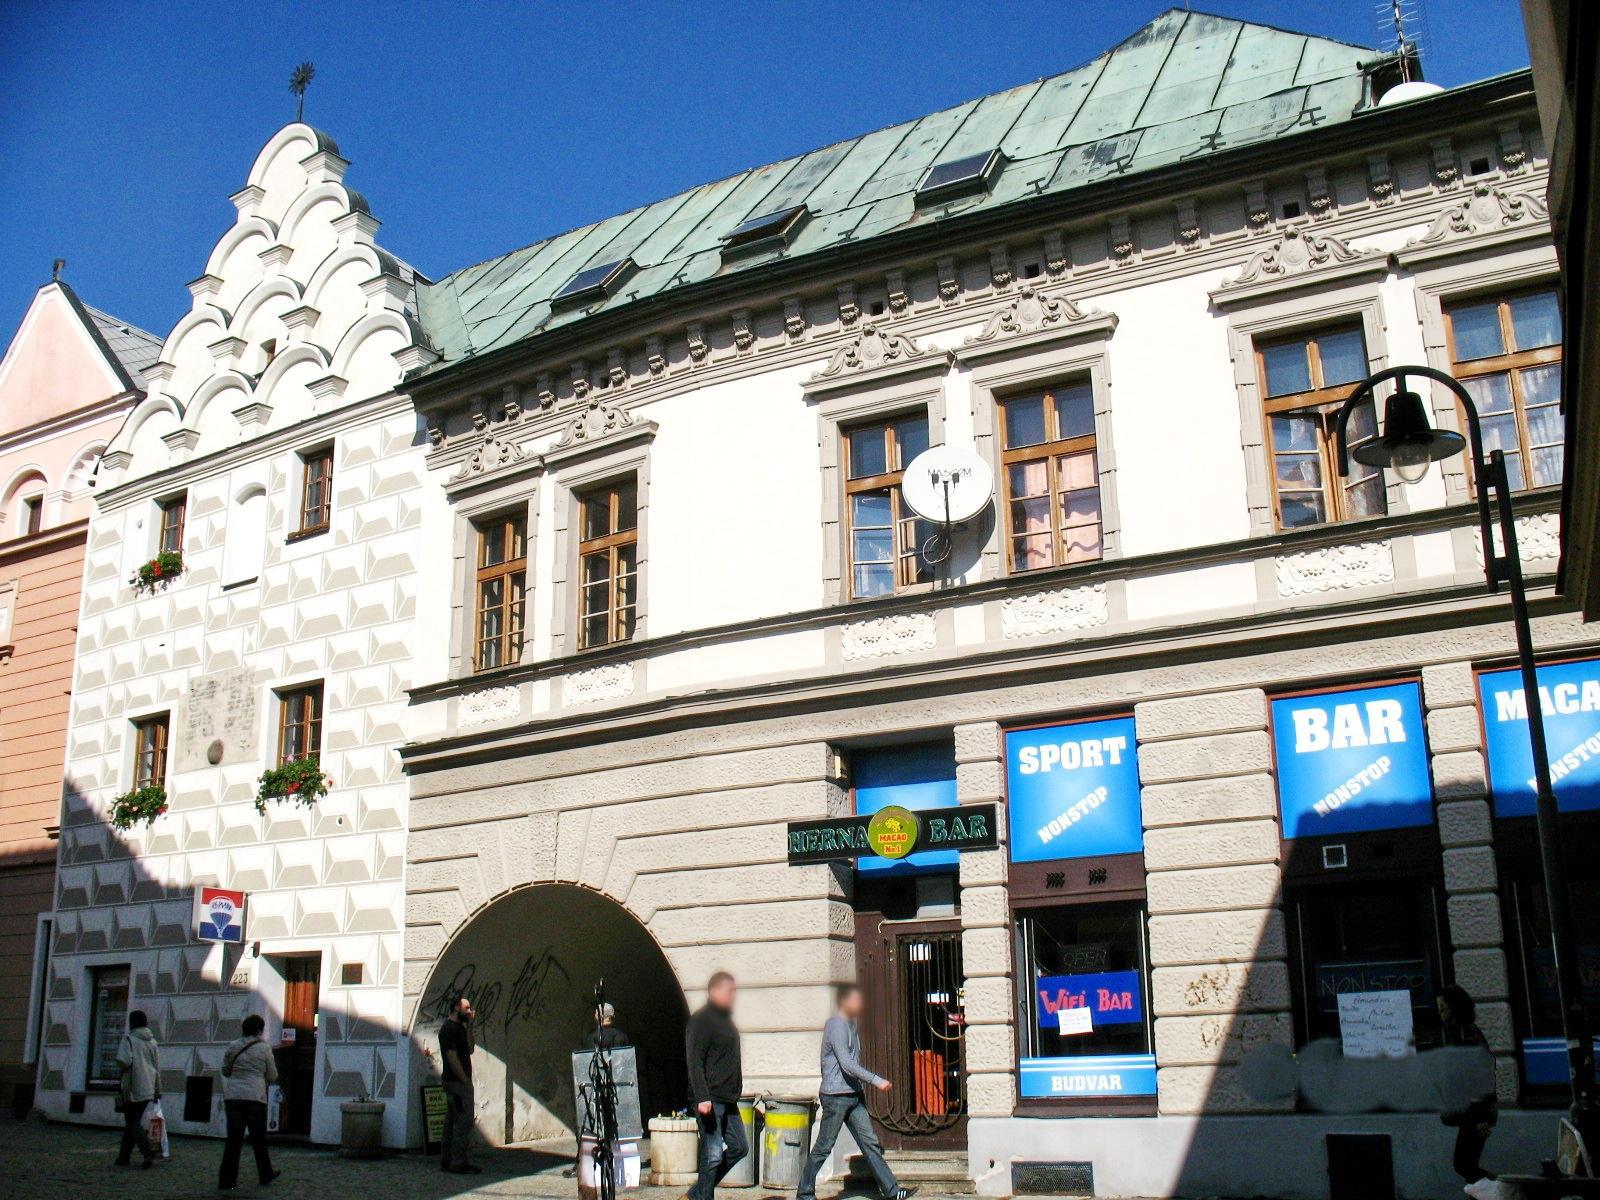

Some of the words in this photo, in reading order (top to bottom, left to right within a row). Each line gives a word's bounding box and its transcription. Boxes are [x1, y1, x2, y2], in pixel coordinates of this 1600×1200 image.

[1292, 699, 1406, 753] BAR
[1018, 735, 1126, 775] SPORT
[1312, 755, 1391, 817] NONSTOP
[788, 825, 869, 853] HERNA
[929, 814, 988, 843] BAR
[1037, 786, 1108, 844] NONSTOP
[879, 833, 907, 842] MACAO
[1063, 951, 1107, 967] OPEN
[232, 973, 248, 985] 223
[1051, 1074, 1122, 1092] BUDVAR
